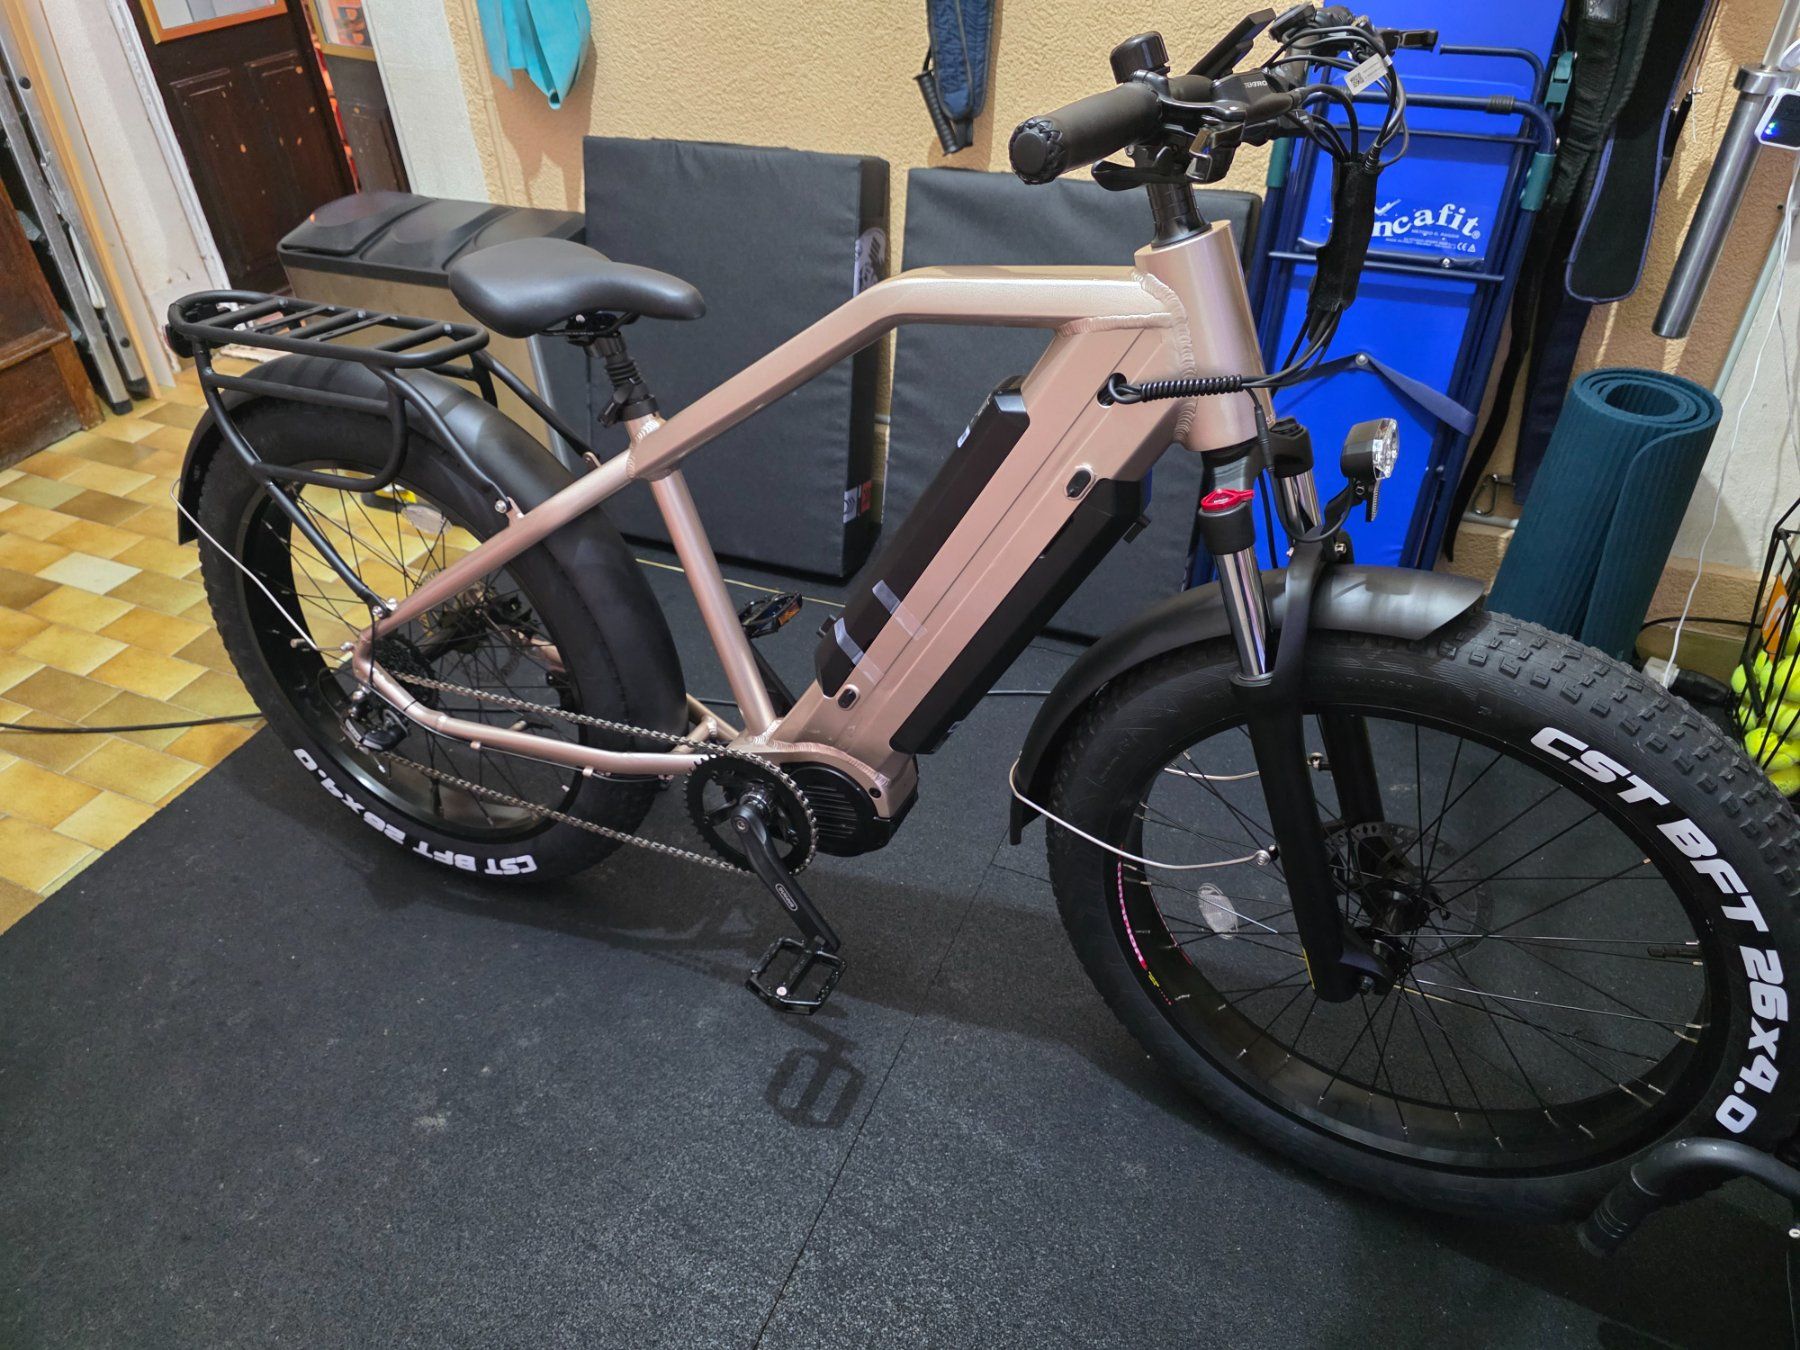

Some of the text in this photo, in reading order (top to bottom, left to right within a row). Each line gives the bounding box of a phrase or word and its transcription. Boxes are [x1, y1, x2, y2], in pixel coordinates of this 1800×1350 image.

[1530, 726, 1671, 806] CST
[1656, 818, 1770, 932] BFT
[412, 840, 477, 872] BFT
[484, 854, 538, 875] CST
